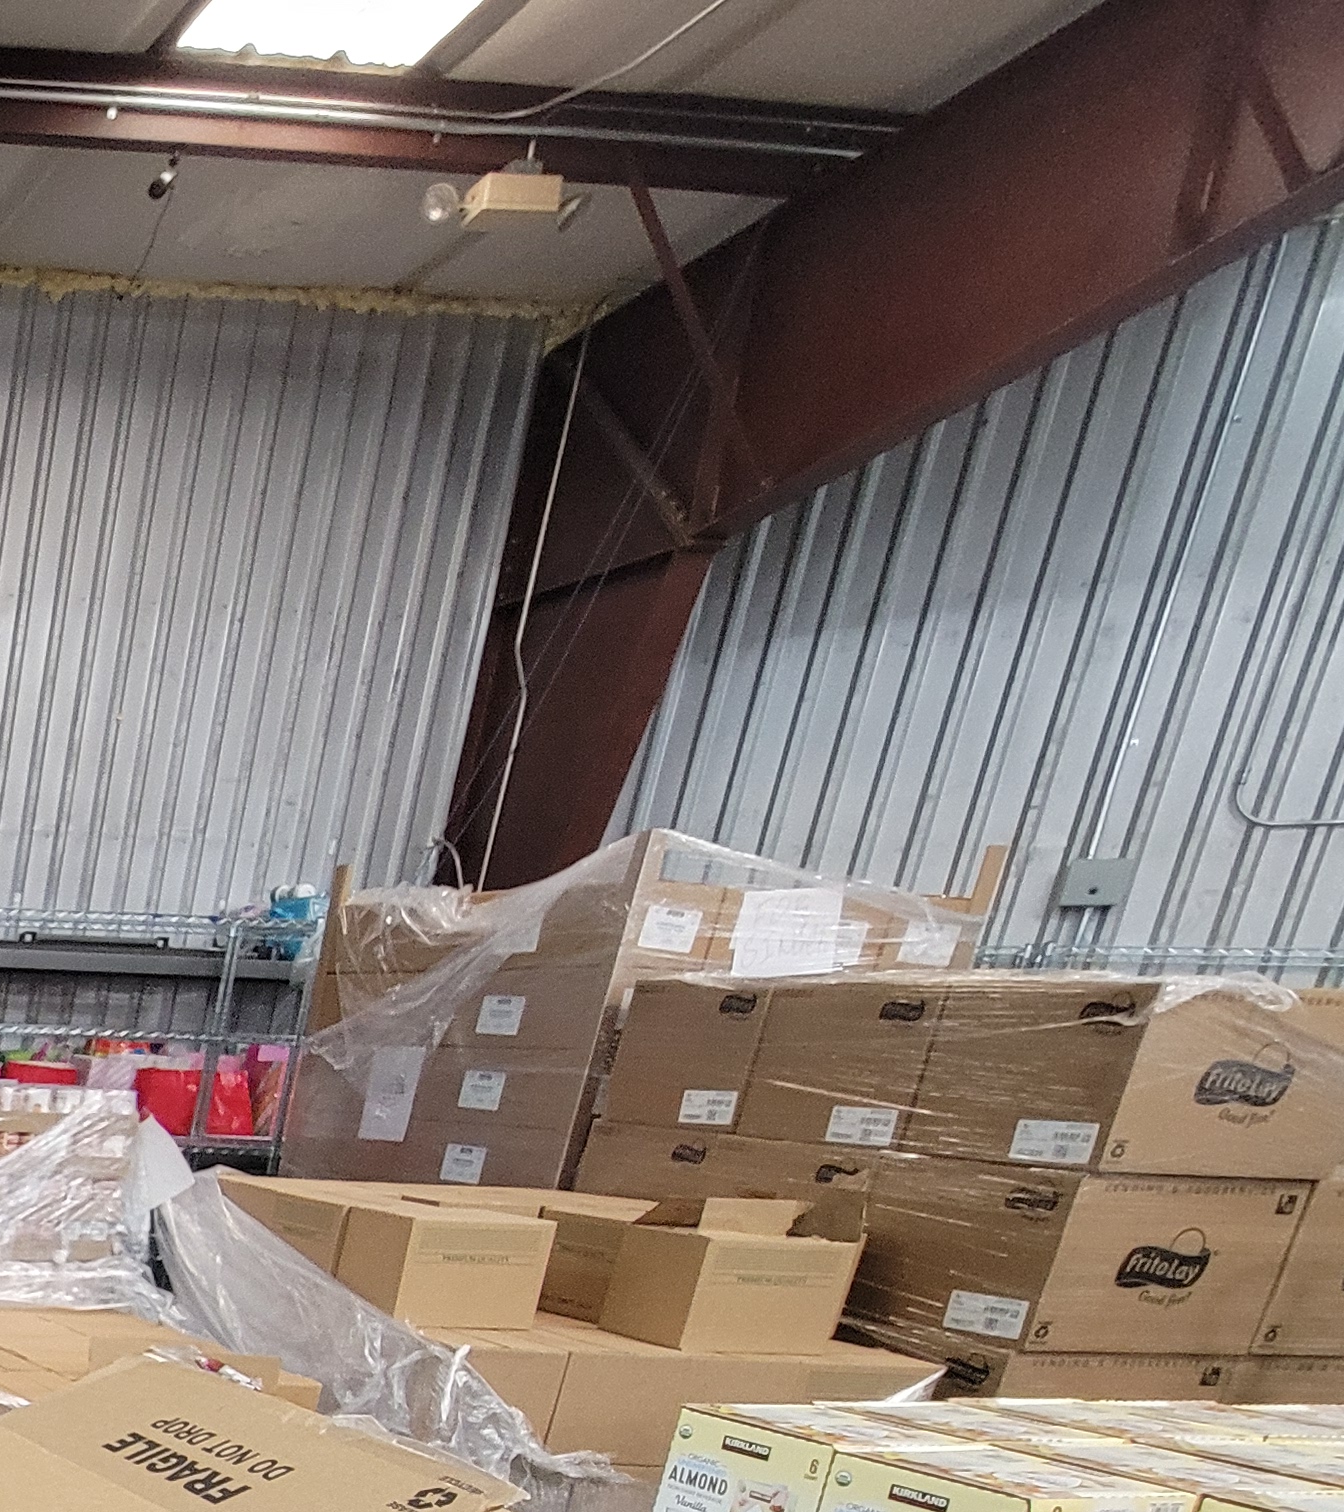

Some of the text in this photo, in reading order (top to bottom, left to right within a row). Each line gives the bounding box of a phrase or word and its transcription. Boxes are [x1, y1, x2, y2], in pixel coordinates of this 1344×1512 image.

[150, 1417, 295, 1481] DO NOT DROP
[725, 1436, 771, 1458] KIRKLAND
[101, 1431, 253, 1505] FRAGILE
[668, 1464, 729, 1497] ALMOND
[808, 1459, 820, 1475] 6
[891, 1485, 948, 1510] KIRKLAND
